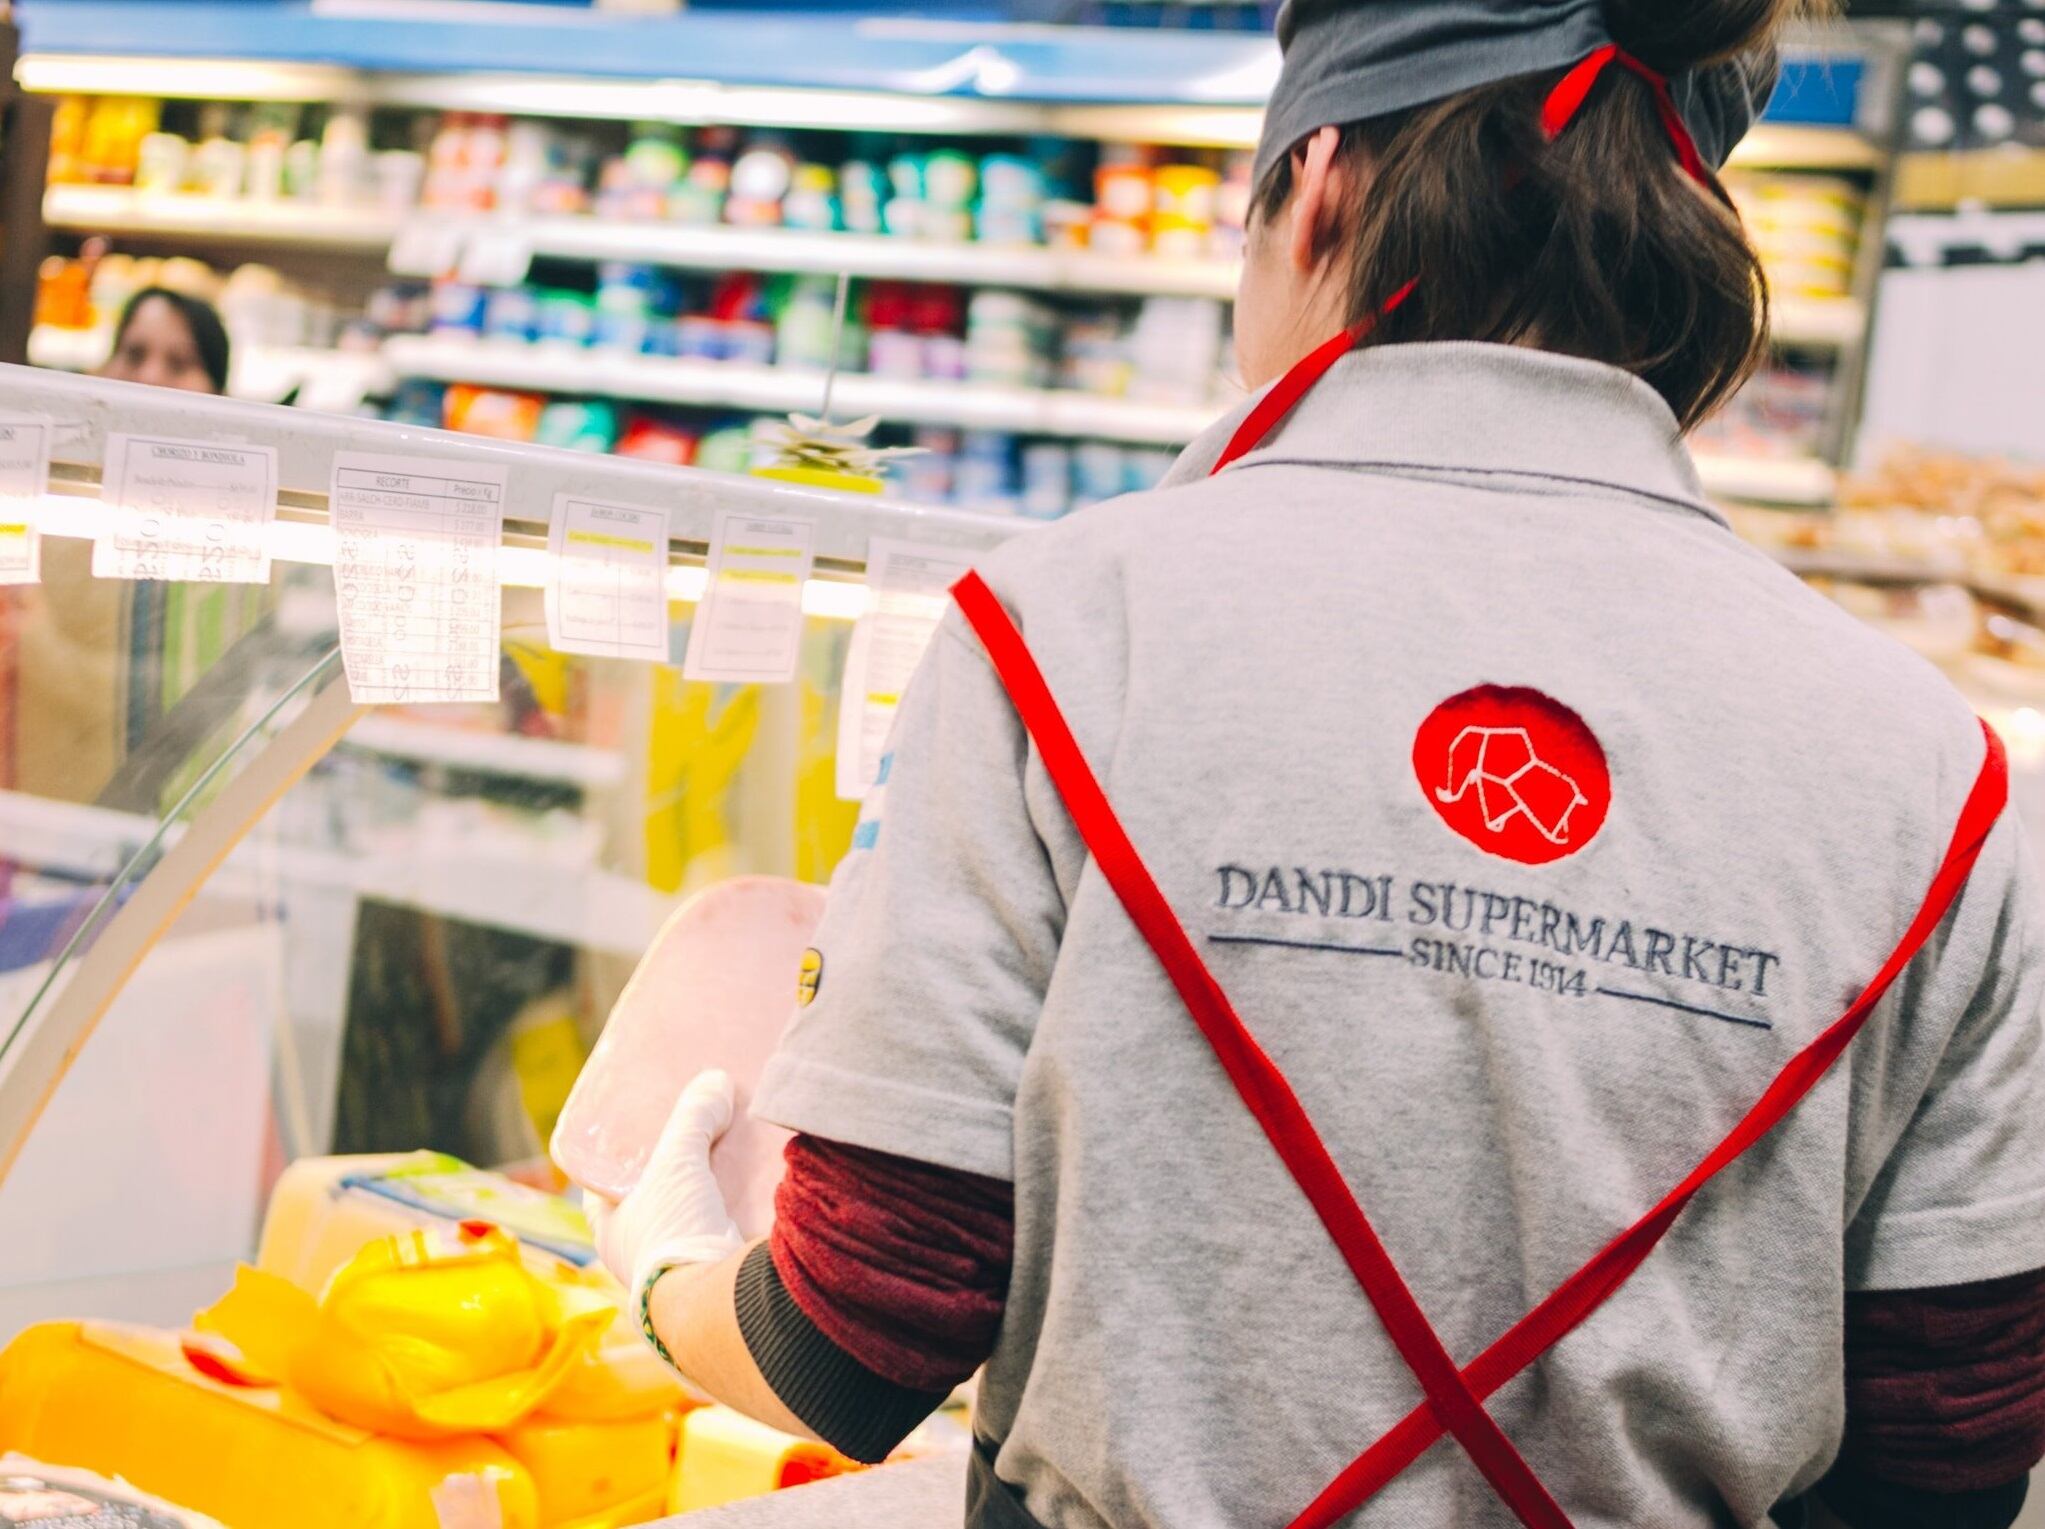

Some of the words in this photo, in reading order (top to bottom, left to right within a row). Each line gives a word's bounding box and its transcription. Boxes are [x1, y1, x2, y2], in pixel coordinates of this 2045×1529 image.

[375, 475, 410, 489] RECORTE
[453, 483, 477, 497] Precio
[1216, 863, 1394, 922] DANDI
[1408, 880, 1780, 997] SUPERMARKET
[1409, 937, 1522, 983] SINCE
[1529, 958, 1588, 998] 1914
